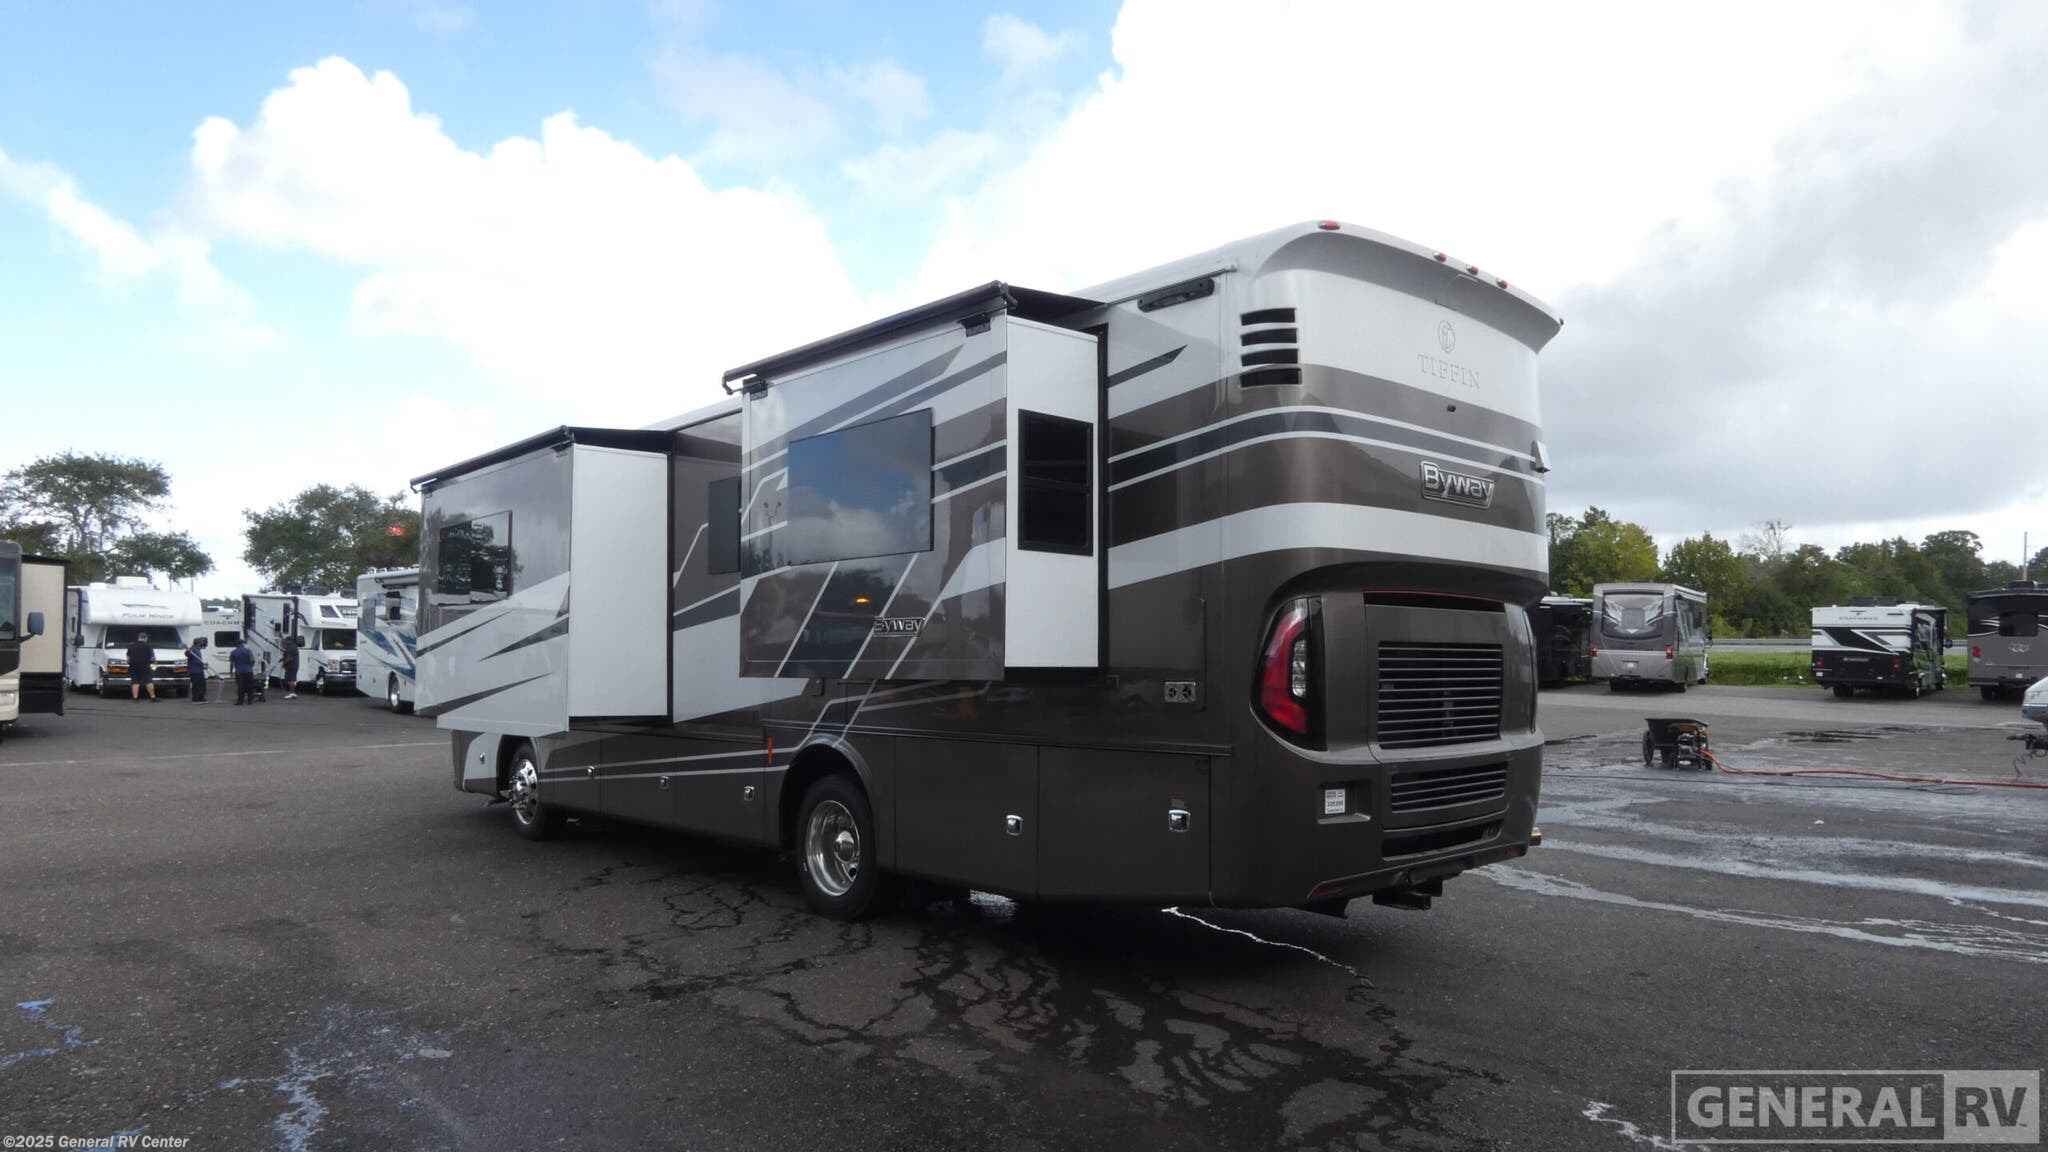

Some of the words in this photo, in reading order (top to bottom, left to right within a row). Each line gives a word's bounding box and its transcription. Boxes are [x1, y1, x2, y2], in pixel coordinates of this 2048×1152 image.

[1416, 352, 1481, 389] TIFFIN
[1423, 464, 1493, 505] Byway
[874, 619, 923, 634] Byway
